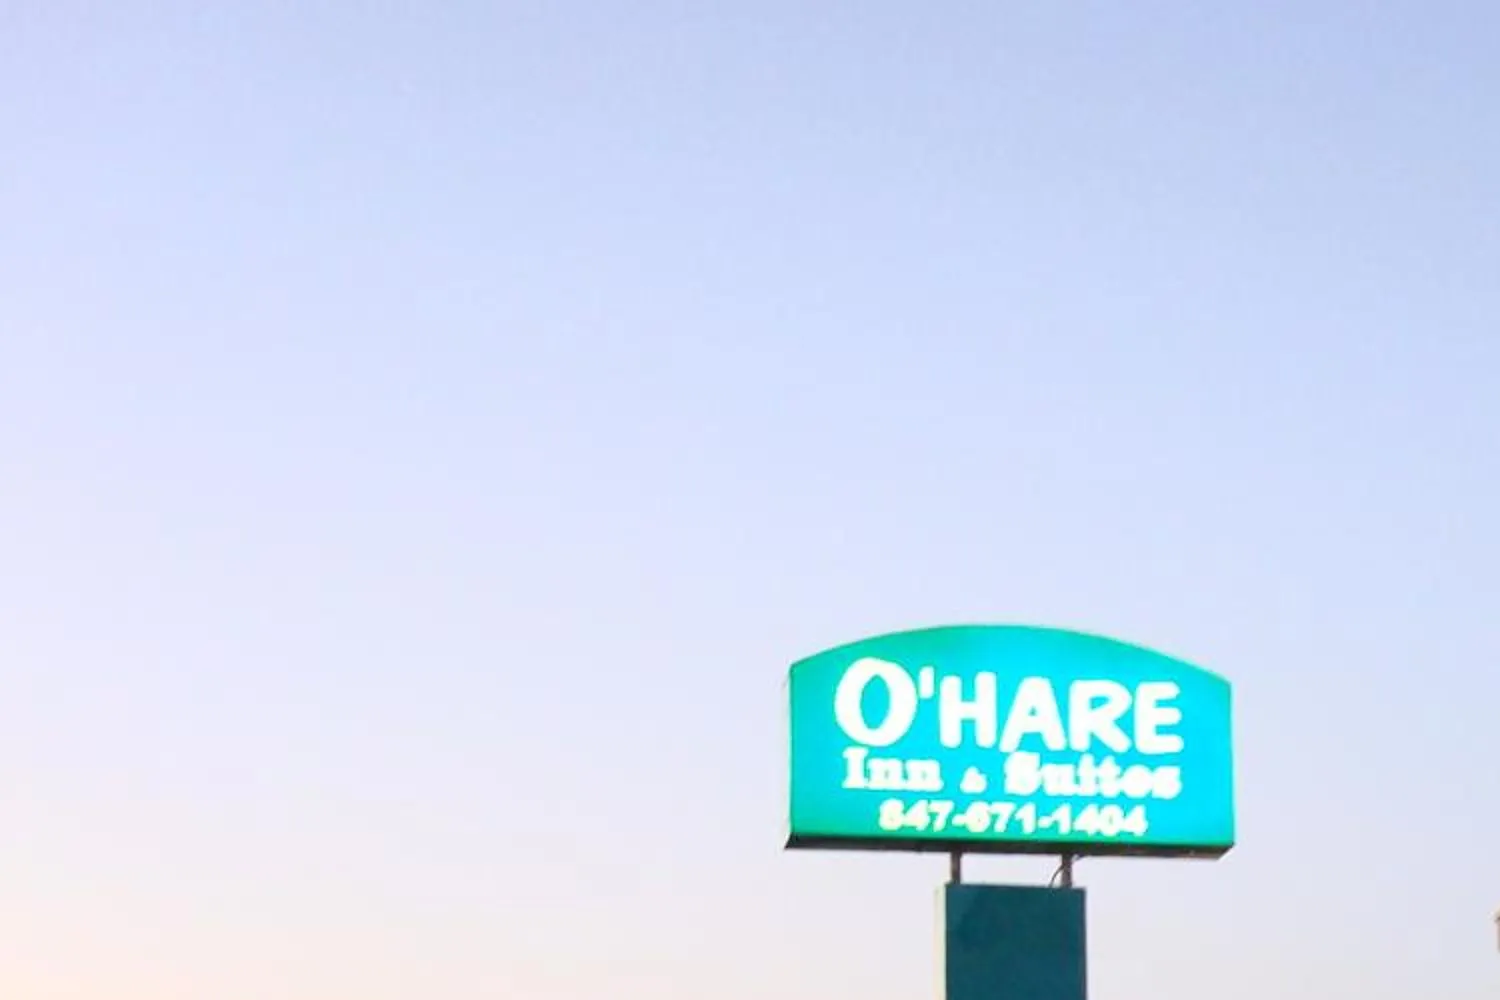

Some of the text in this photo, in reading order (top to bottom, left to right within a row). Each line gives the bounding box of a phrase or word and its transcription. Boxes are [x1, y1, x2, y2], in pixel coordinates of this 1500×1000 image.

[834, 657, 1184, 754] O'HARE
[842, 748, 944, 792] Inn
[1004, 751, 1183, 799] Suites
